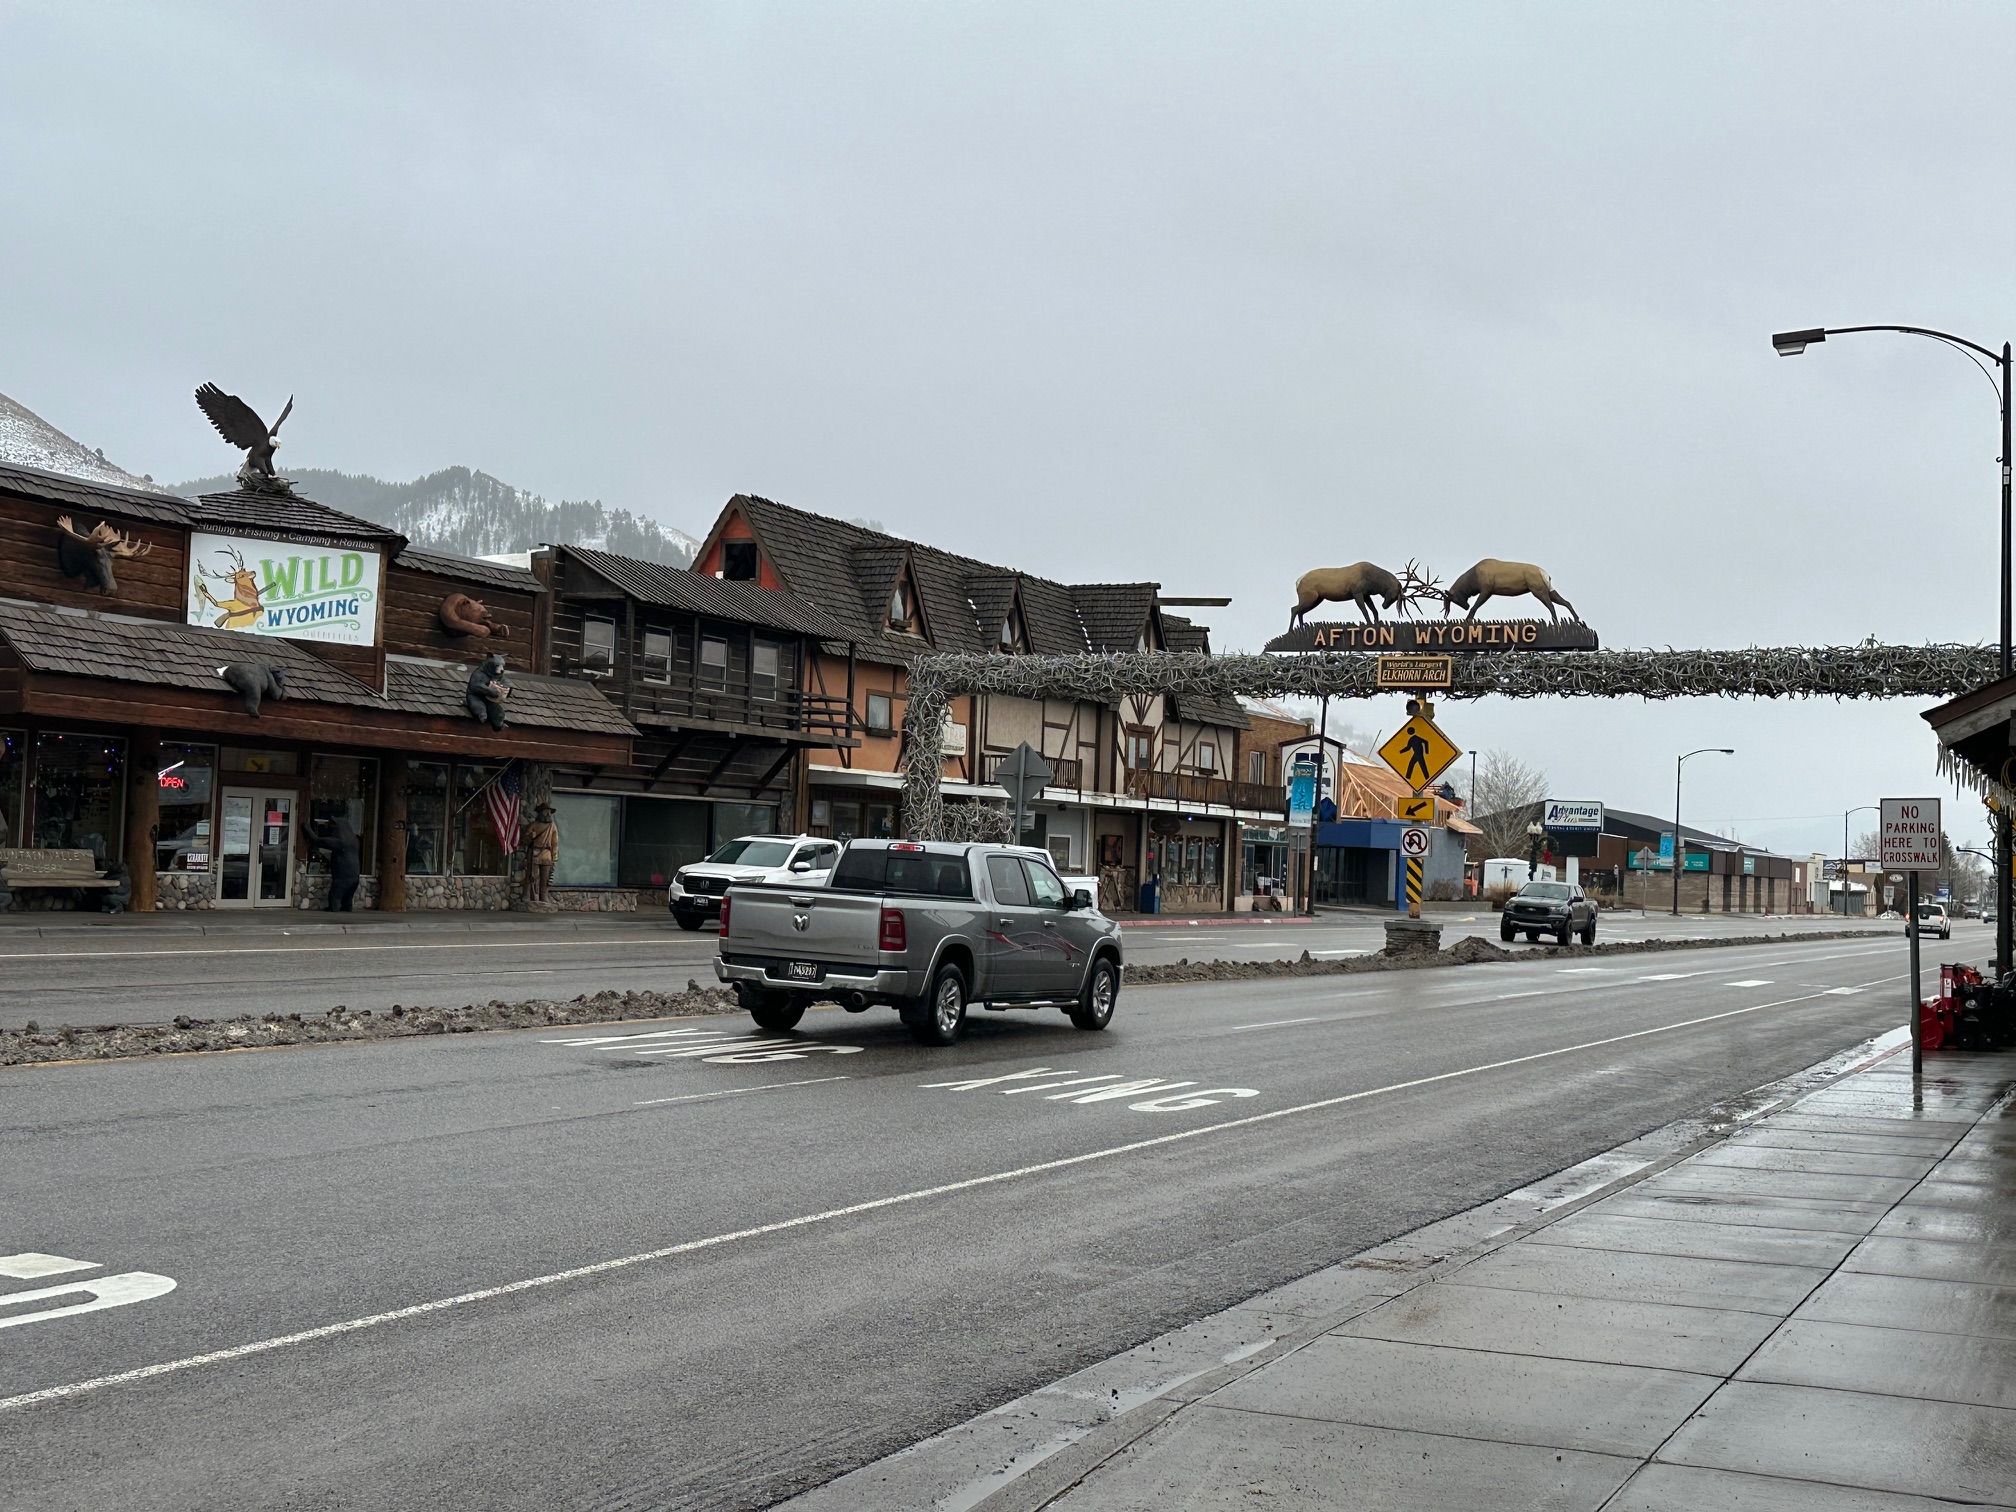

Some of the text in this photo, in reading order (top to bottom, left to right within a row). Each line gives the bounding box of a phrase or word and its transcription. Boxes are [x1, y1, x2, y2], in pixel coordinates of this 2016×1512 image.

[244, 527, 280, 541] Fishing
[289, 533, 331, 547] Camping
[339, 538, 375, 550] Rentals
[259, 552, 364, 601] WILD
[268, 597, 359, 627] WYOMING
[1314, 624, 1538, 647] AFTON WYOMING
[1415, 661, 1443, 669] Largest
[1382, 669, 1446, 681] ELKHORN ARCH
[160, 777, 184, 788] OPEN
[1547, 805, 1599, 820] Advantage
[1901, 805, 1919, 819] NO
[1886, 822, 1935, 834] PARKING
[1884, 837, 1937, 848] HERE TO
[1883, 852, 1938, 863] CROSSWALK
[918, 1067, 1261, 1112] XING
